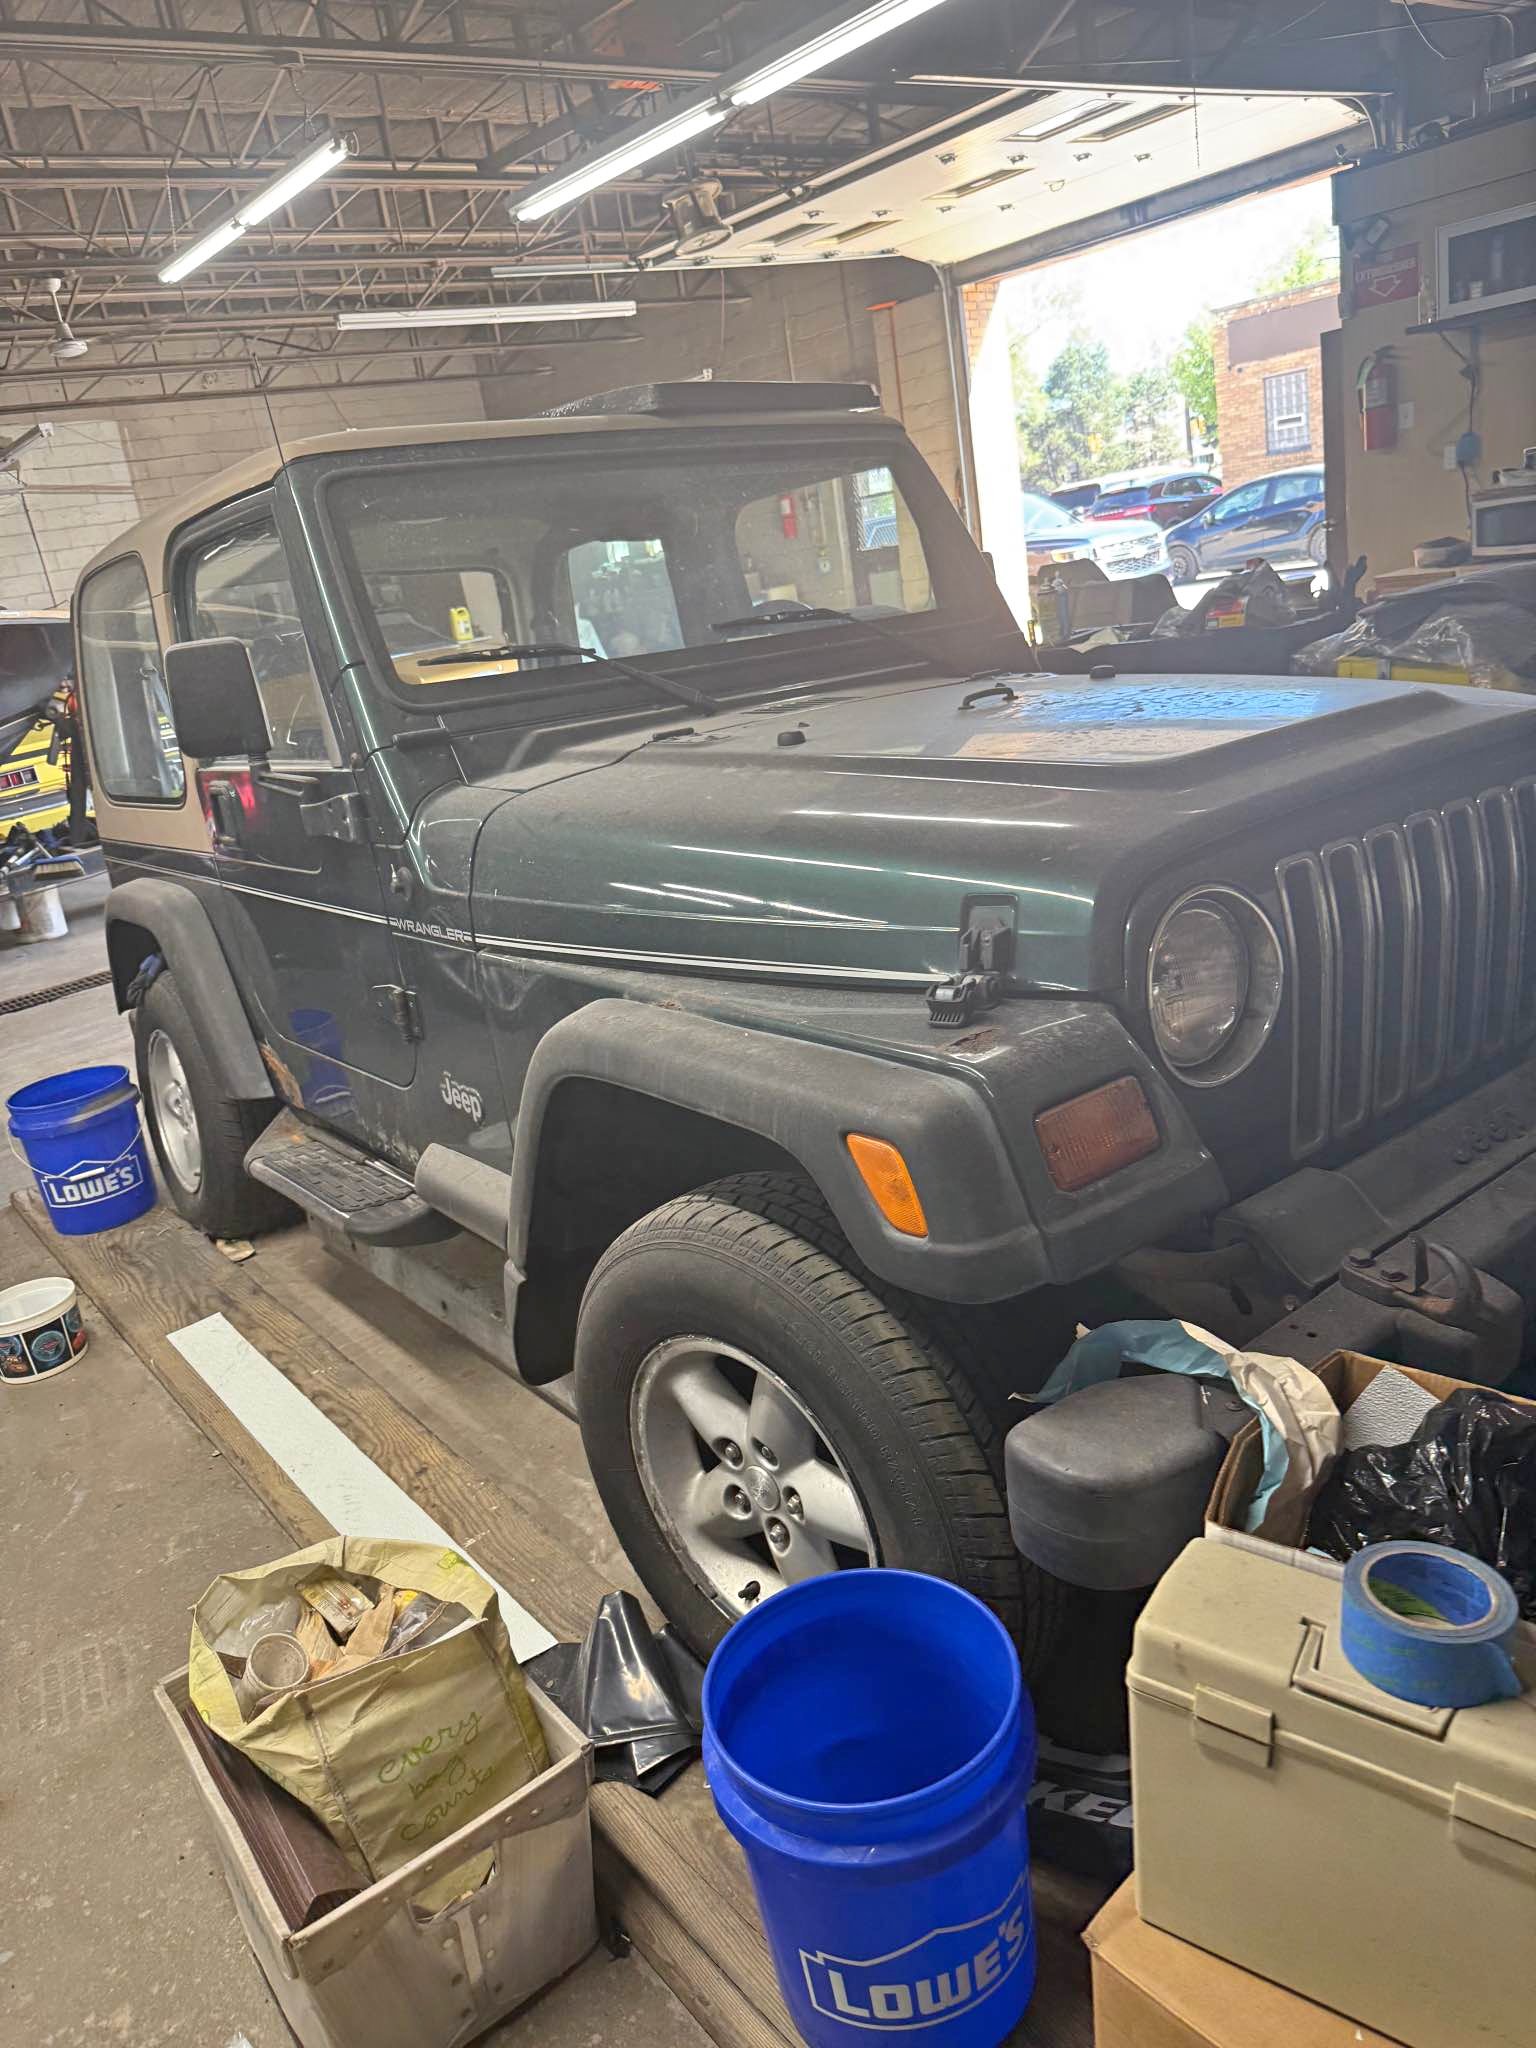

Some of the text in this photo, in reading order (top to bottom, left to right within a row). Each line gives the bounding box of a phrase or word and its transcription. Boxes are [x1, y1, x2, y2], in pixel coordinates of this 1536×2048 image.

[398, 918, 465, 943] WRANGLER
[441, 1071, 482, 1122] Jeep
[49, 1166, 134, 1203] LOWE'S
[378, 1712, 482, 1784] every
[407, 1754, 466, 1800] bag
[828, 1905, 1025, 2020] LOWE'S
